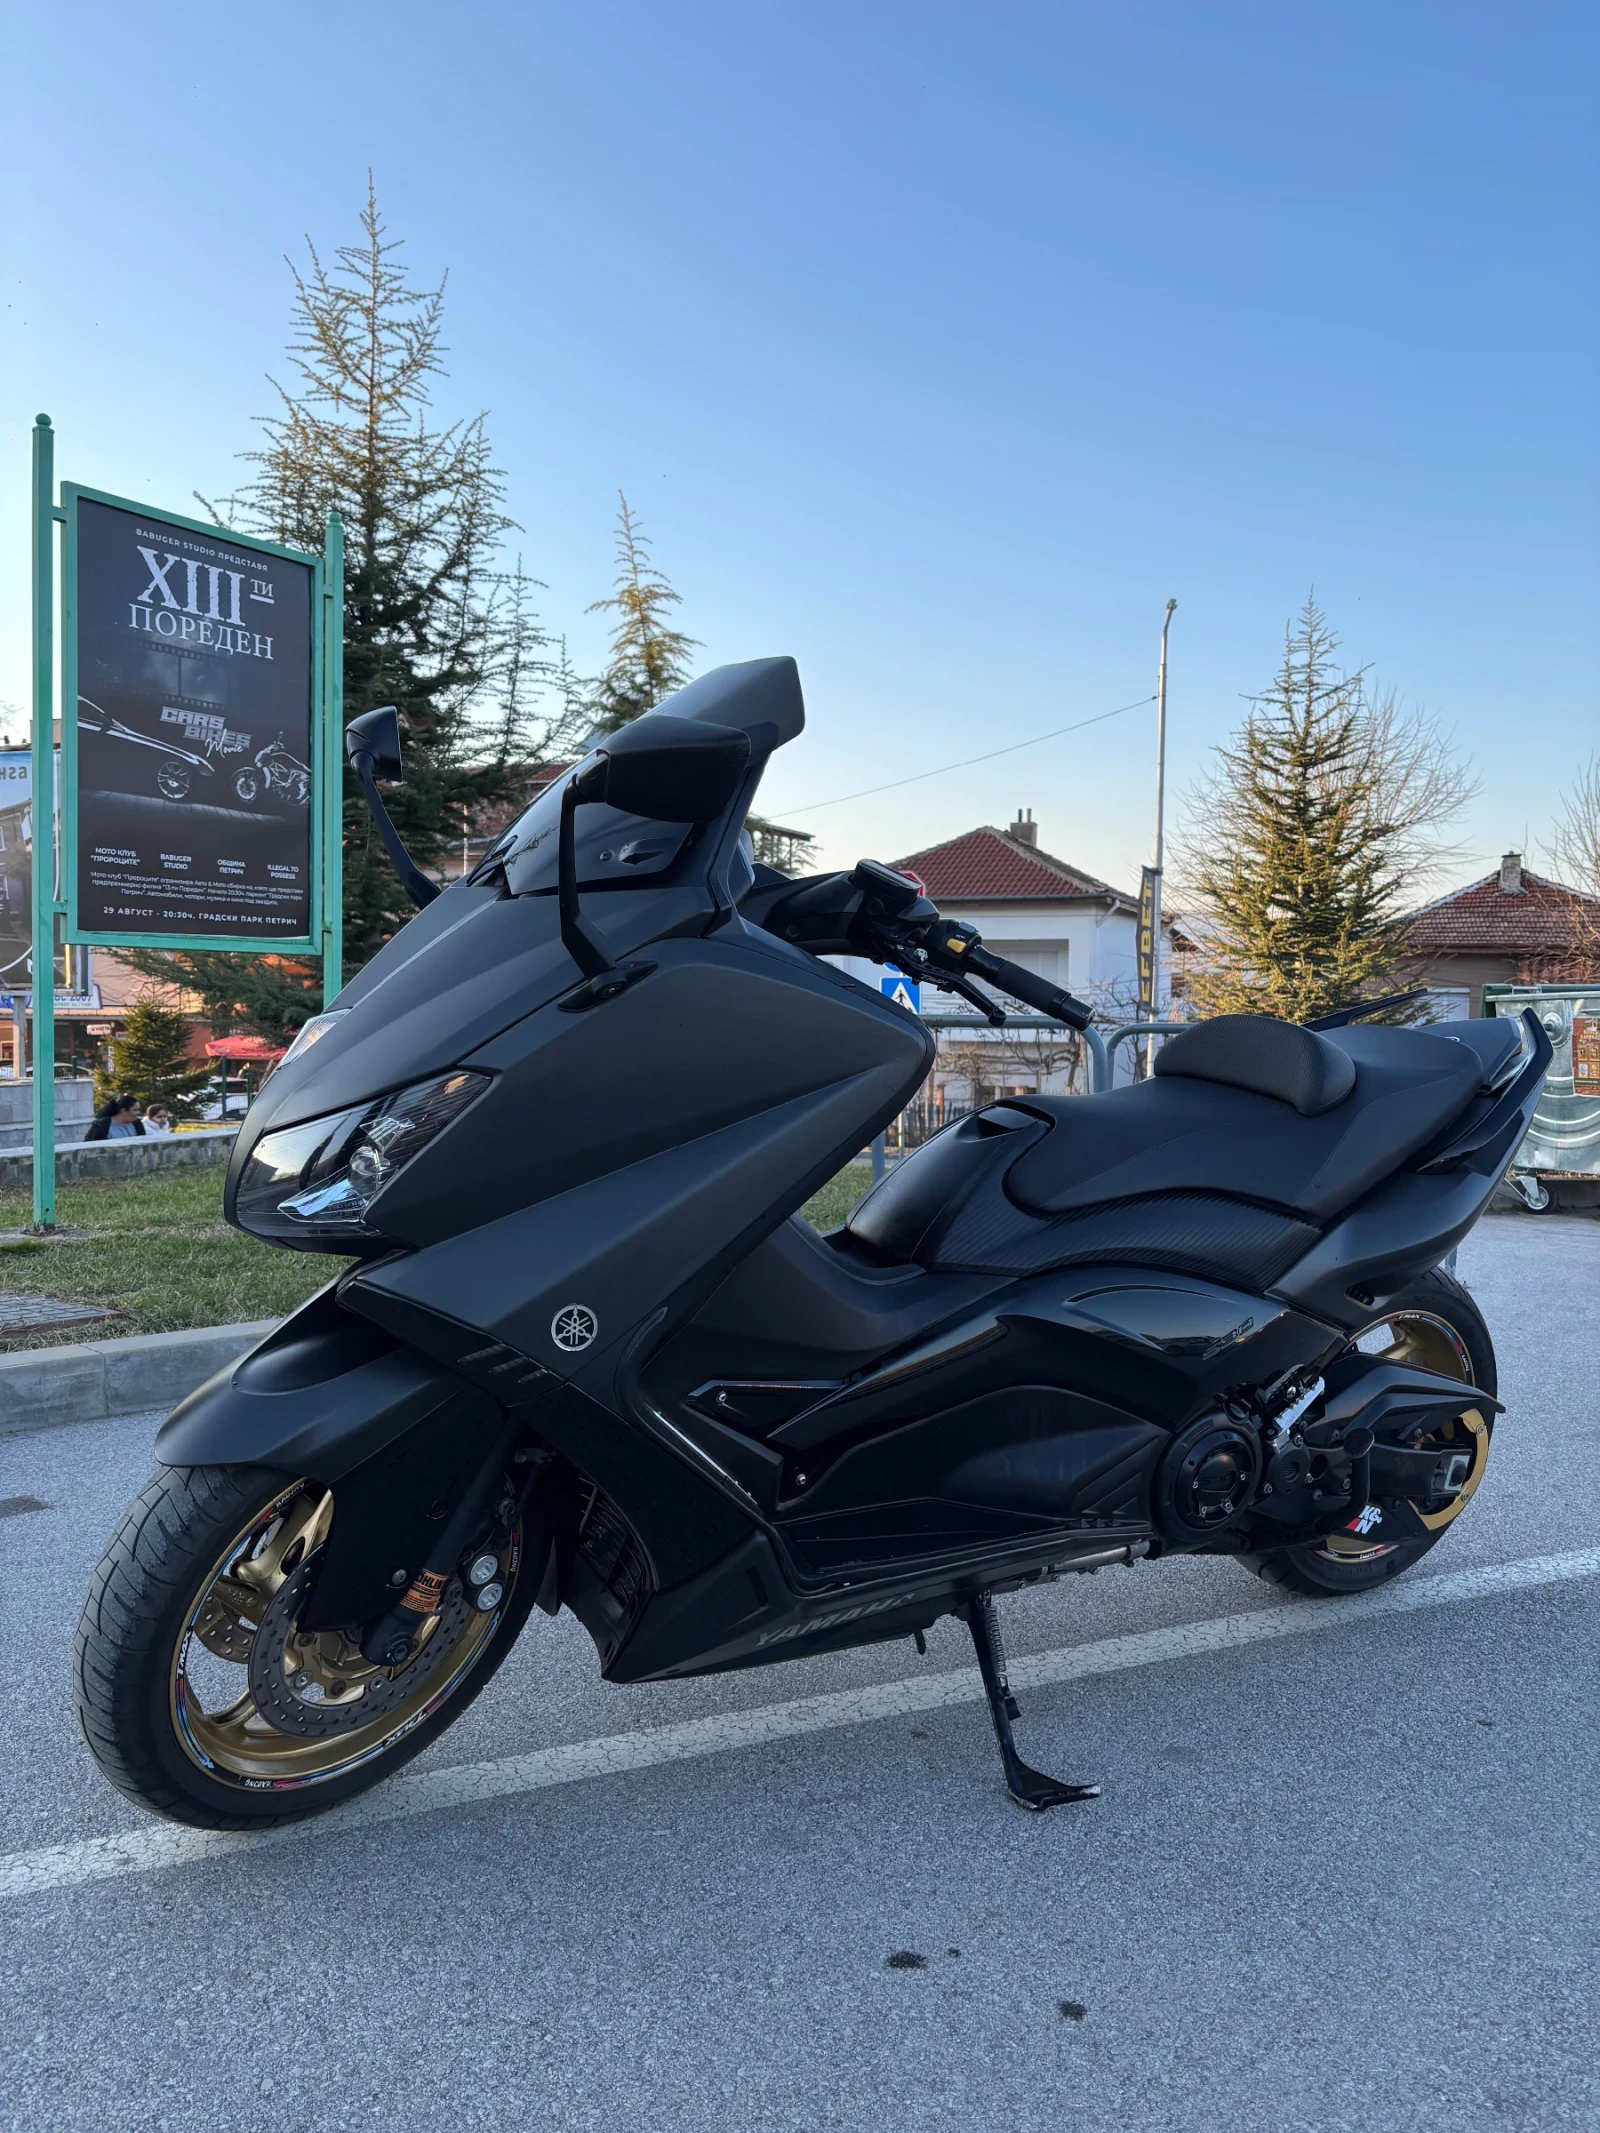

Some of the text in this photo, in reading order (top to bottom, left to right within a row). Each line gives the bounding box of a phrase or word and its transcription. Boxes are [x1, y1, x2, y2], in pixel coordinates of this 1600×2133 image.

[136, 528, 268, 572] BABUGER STUDIO ПРЕДСТАВЯ
[136, 545, 246, 627] XIII
[128, 603, 274, 660] ПОРЕДЕН
[160, 706, 226, 730] CARS
[204, 728, 244, 759] Movie
[95, 847, 137, 858] МОТО КЛУБ
[160, 853, 192, 863] BABUGER
[163, 862, 188, 870] STUDIO
[217, 859, 246, 868] ОБЩИНА
[219, 867, 244, 875] ПЕТРИЧ
[267, 864, 290, 872] ILLEGAL
[270, 872, 296, 880] POSSESS
[103, 906, 115, 915] 29
[117, 908, 153, 917] АВГУСТ
[198, 913, 238, 922] ГРАДСКИ
[241, 915, 263, 924] ПАРК
[265, 917, 297, 925] ПЕТРИЧ
[1141, 876, 1153, 1002] EFBET
